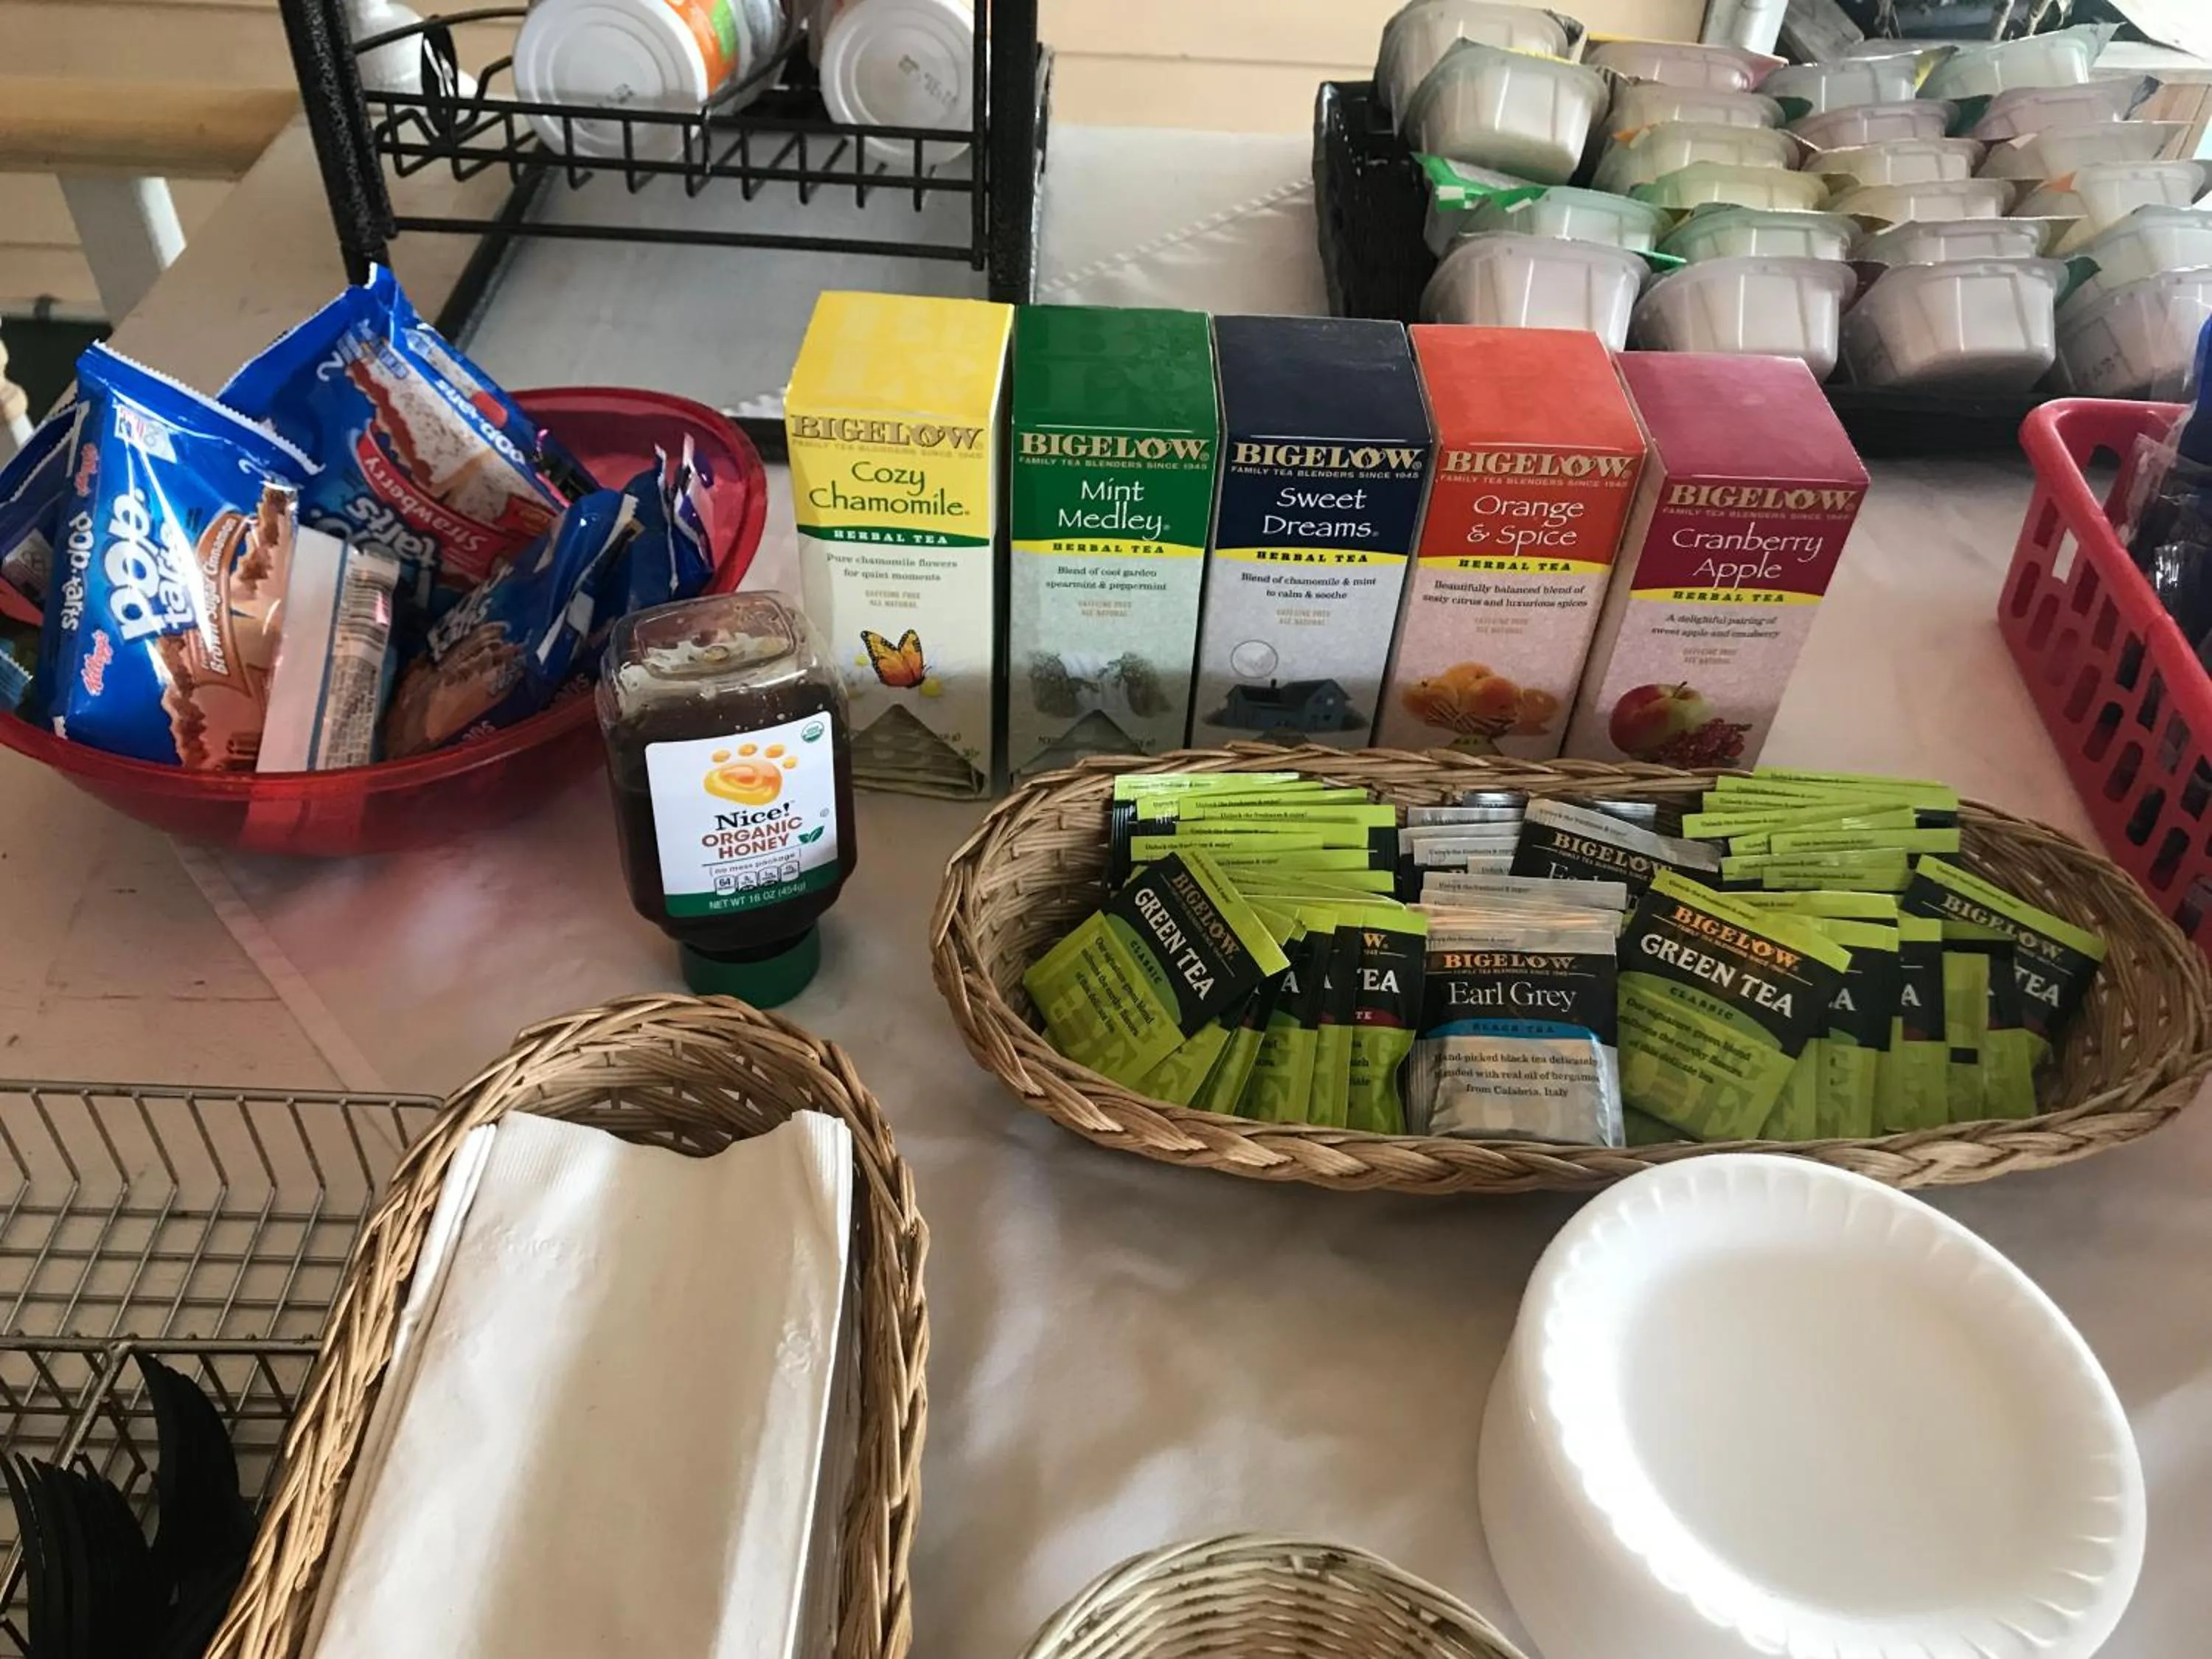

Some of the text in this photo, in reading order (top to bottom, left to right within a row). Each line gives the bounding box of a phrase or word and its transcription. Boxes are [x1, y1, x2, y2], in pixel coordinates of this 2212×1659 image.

[790, 414, 984, 450] BIGELOW
[1018, 432, 1210, 461] BIGELOW
[1232, 442, 1425, 470] BIGELOW
[1019, 457, 1055, 466] FAMILY
[1062, 459, 1080, 467] TEA
[1085, 460, 1142, 469] BLENDERS
[1231, 465, 1269, 476] FAMILY
[1273, 469, 1293, 477] TEA
[1297, 470, 1354, 479] BLENDERS
[1358, 471, 1390, 479] SINCE
[1440, 450, 1638, 479] BIGELOW
[851, 461, 925, 496] Cozy
[1081, 477, 1145, 501] Mint
[1439, 474, 1477, 484] FAMILY
[1483, 476, 1503, 484] TEA
[1507, 477, 1564, 487] BLENDERS
[1567, 479, 1599, 487] SINCE
[364, 456, 490, 552] Strawberry
[809, 480, 964, 516] Chamomile
[1276, 487, 1368, 509] Sweet
[1666, 483, 1857, 511] BIGELOW
[1058, 501, 1163, 540] Medley
[1473, 495, 1585, 527] Orange
[834, 530, 947, 544] HERBAL TEA
[1262, 515, 1372, 538] Dreams
[1053, 543, 1164, 554] HERBAL TEA
[1467, 524, 1578, 557] & Spice
[1672, 521, 1823, 563] Cranberry
[827, 553, 853, 563] Pure
[1256, 551, 1368, 563] HERBAL TEA
[1458, 559, 1571, 571] HERBAL TEA
[844, 568, 860, 577] for
[891, 572, 941, 582] moments
[1057, 566, 1087, 576] Blend
[1088, 566, 1099, 577] of
[1122, 568, 1157, 580] garden
[1241, 572, 1376, 586] Blend of chamomile & mint
[1693, 552, 1783, 589] Apple
[1046, 580, 1167, 592] spearmint & peppermint
[1278, 590, 1303, 599] calm
[1304, 590, 1312, 599] &
[1315, 591, 1348, 599] soothe
[1434, 580, 1585, 596] Beautifully balanced blend of
[1672, 591, 1784, 602] HERBAL TEA
[1452, 596, 1481, 605] citrus
[1484, 597, 1503, 607] and
[1506, 598, 1555, 608] luxurious
[1557, 599, 1587, 610] spices
[1666, 615, 1675, 623] A
[714, 802, 790, 831] Nice!
[702, 816, 803, 847] ORGANIC
[718, 833, 790, 859] HONEY
[709, 898, 728, 909] NET
[730, 896, 745, 907] WT
[750, 894, 761, 903] 16
[762, 890, 776, 900] OZ
[1172, 872, 1240, 959] BIGELOW
[1941, 893, 2065, 960] BIGELOW
[1134, 887, 1186, 955] GREEN
[1177, 947, 1216, 1001] TEA
[1672, 905, 1802, 970] BIGELOW
[1130, 939, 1164, 985] CLASSIC
[1443, 953, 1576, 970] BIGELOW
[1357, 967, 1400, 994] EA
[1641, 933, 1792, 1018] GREEN TEA
[1449, 981, 1577, 1012] Earl Grey
[1669, 987, 1733, 1020] CLASSIC
[1500, 1053, 1528, 1063] black
[1531, 1054, 1547, 1063] tea
[1475, 1069, 1500, 1079] with
[1501, 1070, 1521, 1079] real
[1524, 1071, 1537, 1080] oil
[1540, 1071, 1551, 1080] of
[1552, 1071, 1600, 1083] bergamo
[1466, 1082, 1492, 1093] from
[1545, 1086, 1569, 1098] Italy
